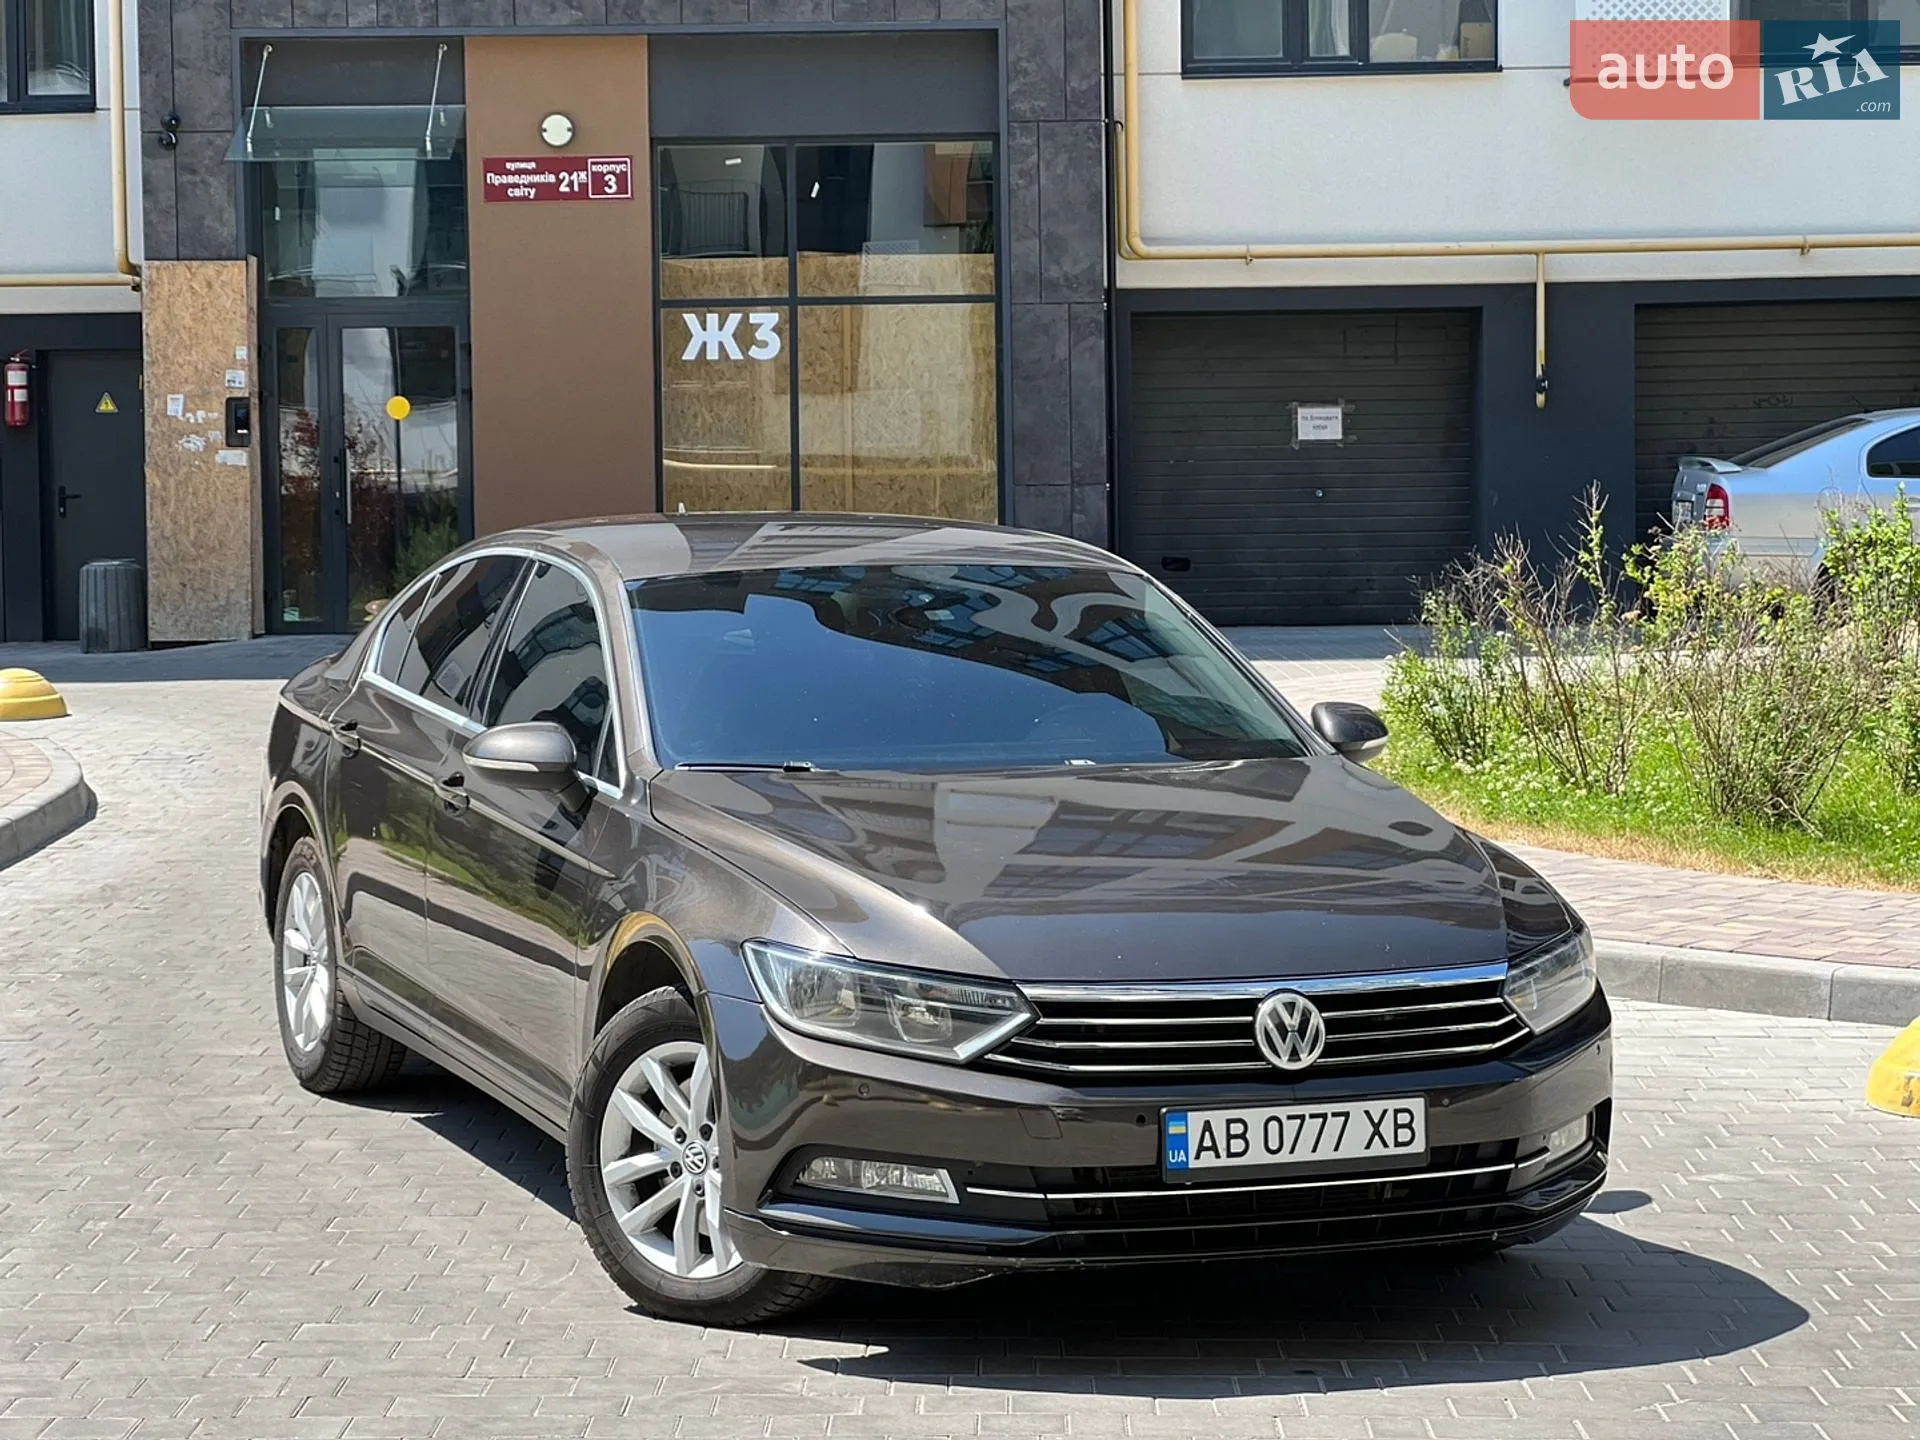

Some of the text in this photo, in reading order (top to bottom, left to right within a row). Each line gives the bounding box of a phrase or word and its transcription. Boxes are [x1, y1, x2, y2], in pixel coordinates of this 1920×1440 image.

[591, 163, 627, 173] корпус
[486, 171, 556, 186] Праведників
[604, 174, 618, 194] 3
[507, 186, 536, 199] світу
[682, 312, 781, 361] Ж3
[1194, 1107, 1416, 1160] AB 0777 XB
[1169, 1151, 1187, 1163] UA
